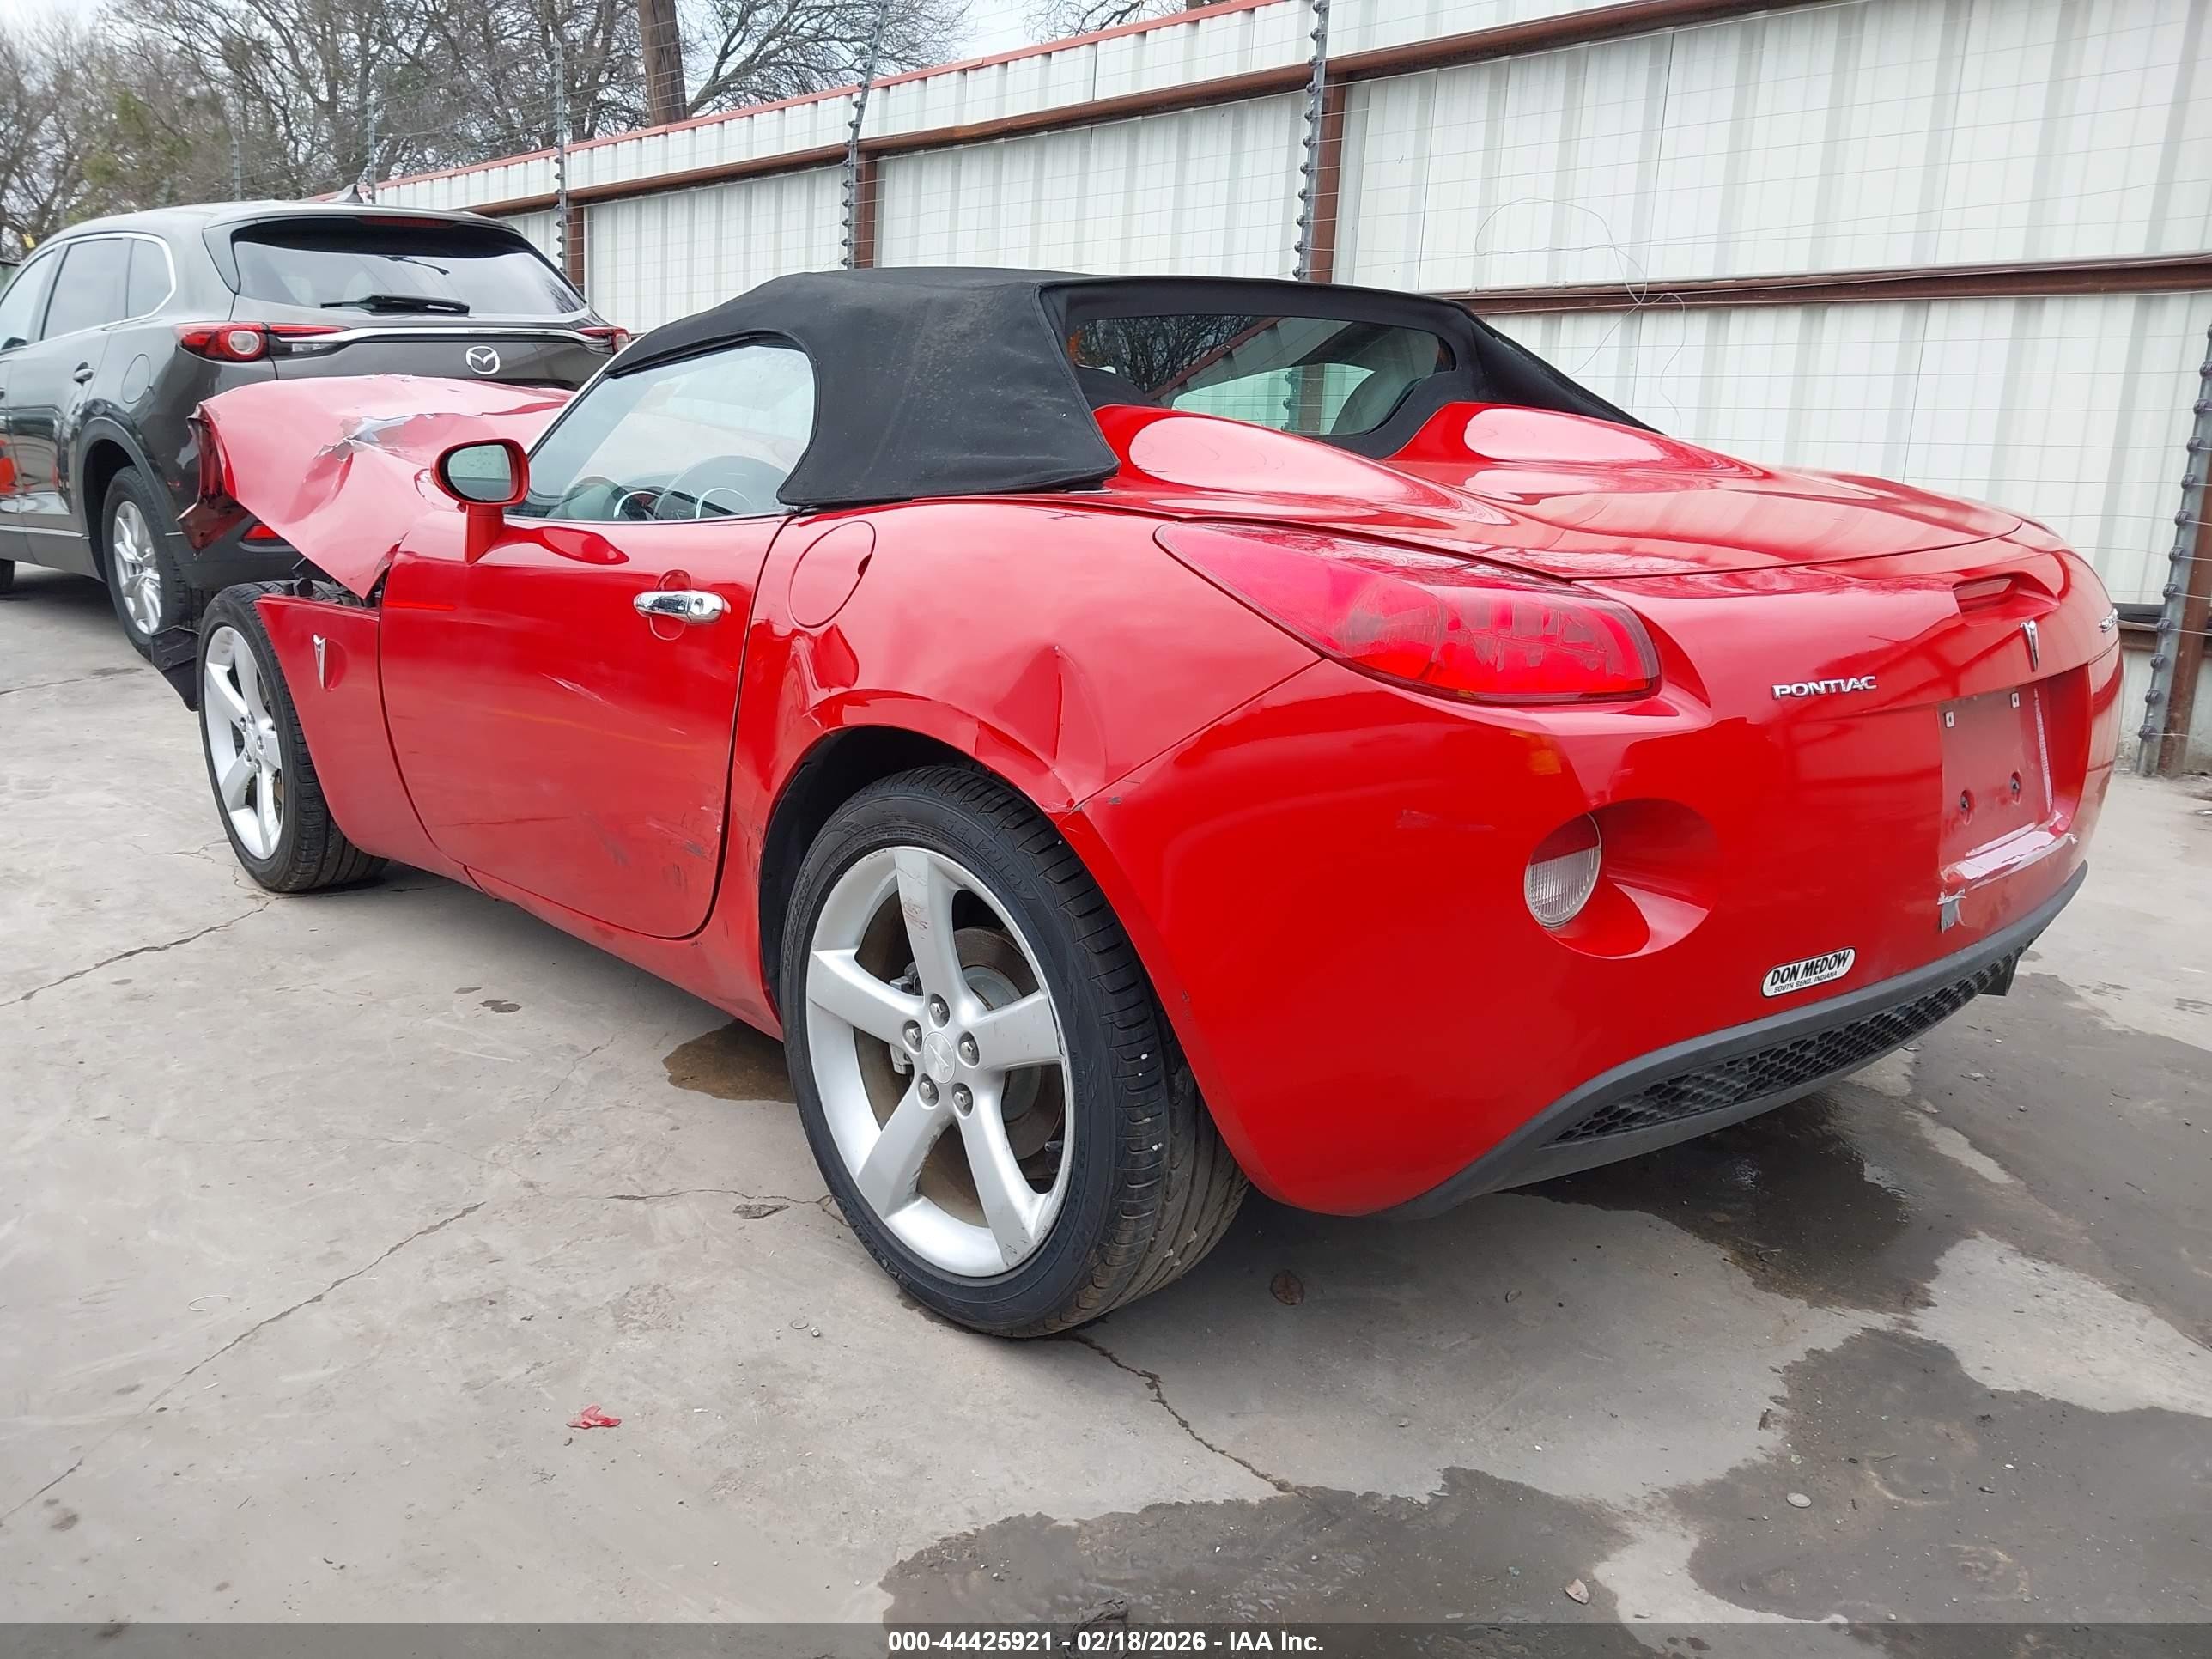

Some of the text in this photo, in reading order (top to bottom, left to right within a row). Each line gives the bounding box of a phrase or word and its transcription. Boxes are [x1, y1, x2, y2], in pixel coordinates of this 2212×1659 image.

[1771, 675, 1878, 700] PONTIAC
[1770, 950, 1851, 987] DON MEDOW
[1773, 981, 1794, 993] SOUTH
[1814, 971, 1838, 982] INDIANA
